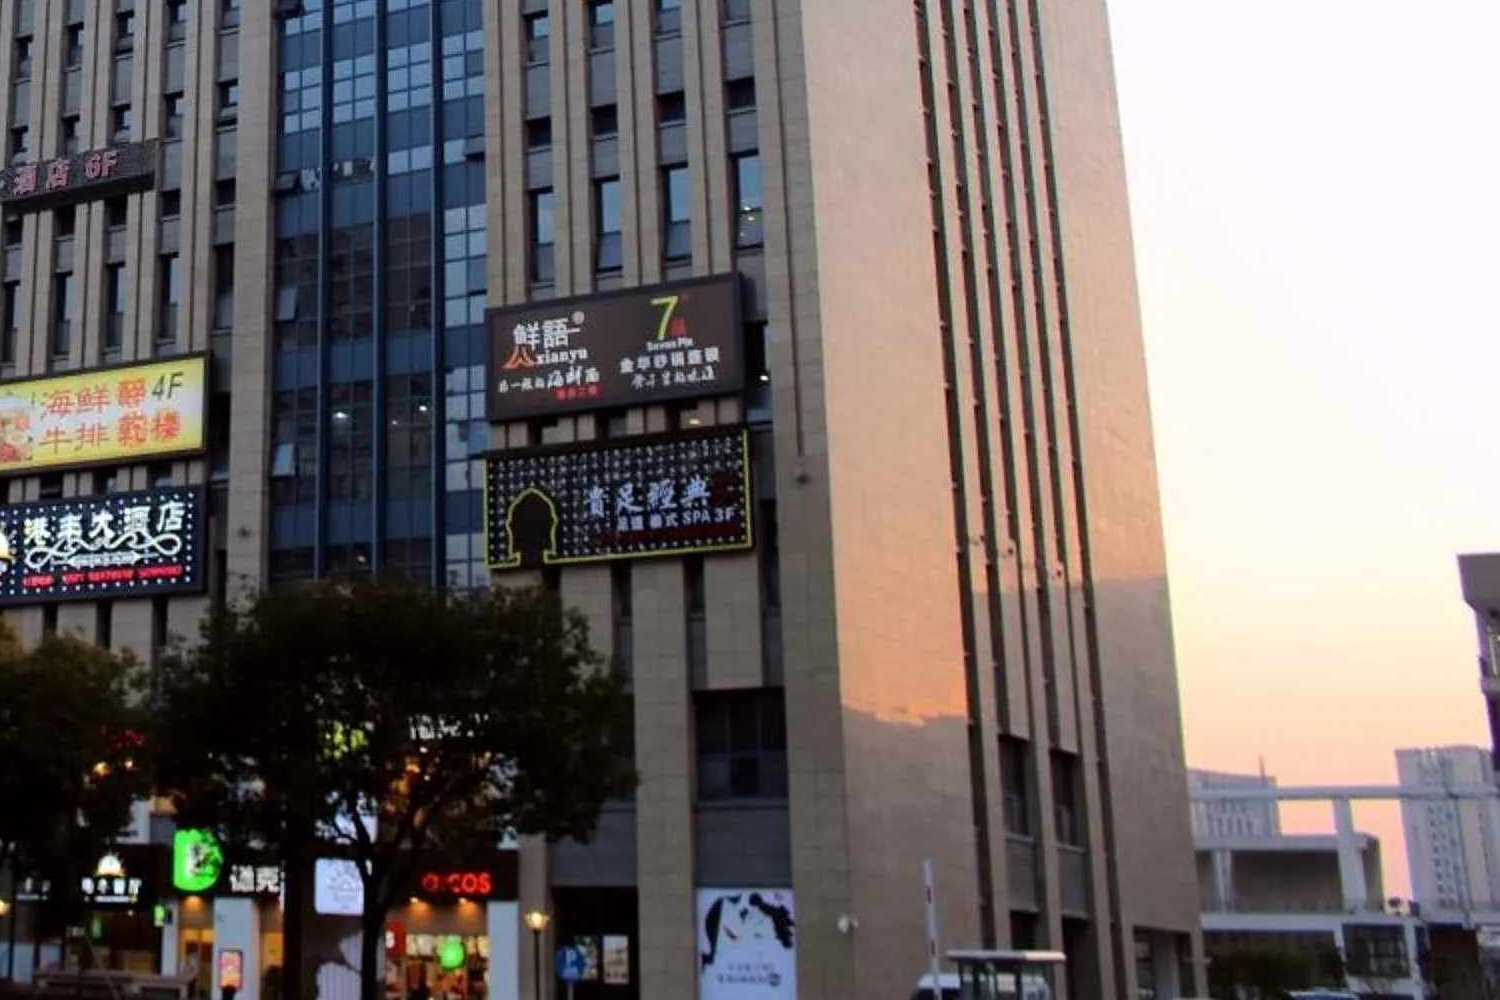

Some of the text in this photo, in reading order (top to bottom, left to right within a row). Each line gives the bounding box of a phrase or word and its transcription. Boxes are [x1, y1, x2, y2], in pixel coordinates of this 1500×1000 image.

[151, 371, 184, 401] 4F
[682, 508, 711, 526] SPA
[714, 506, 735, 523] 3F
